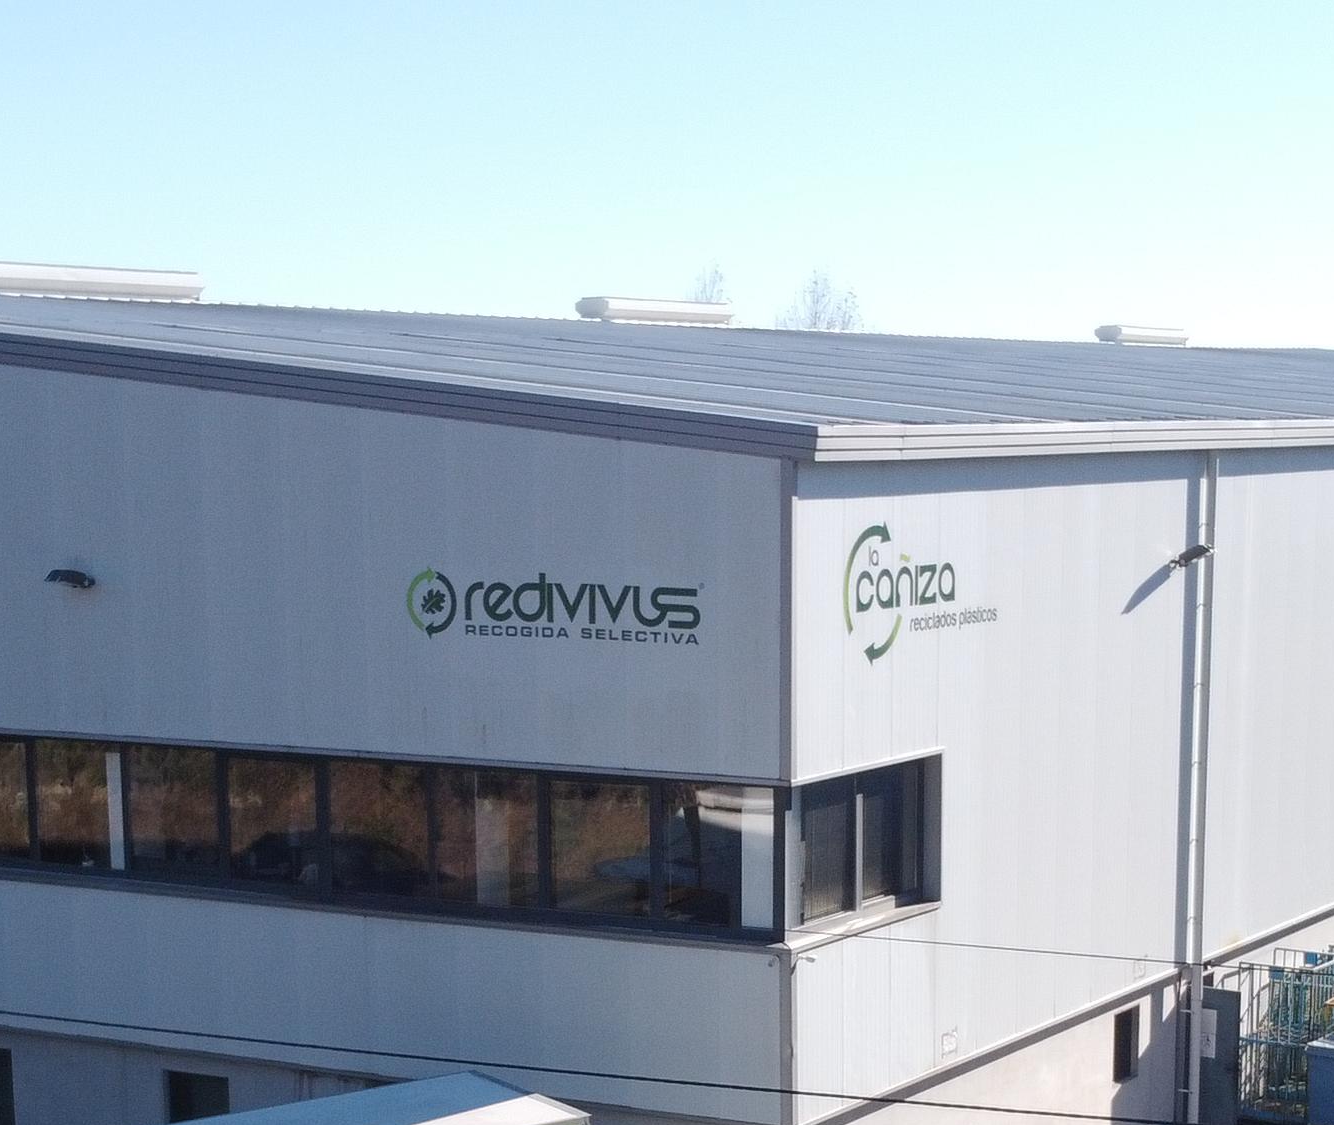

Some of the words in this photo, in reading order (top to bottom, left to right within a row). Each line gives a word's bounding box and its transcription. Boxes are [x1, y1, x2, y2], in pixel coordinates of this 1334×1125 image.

[868, 546, 880, 567] la
[855, 553, 956, 613] cañiza
[464, 572, 701, 630] redivivus
[909, 611, 957, 632] reciclados
[465, 624, 569, 639] RECOGIDA
[580, 627, 700, 645] SELECTIVA
